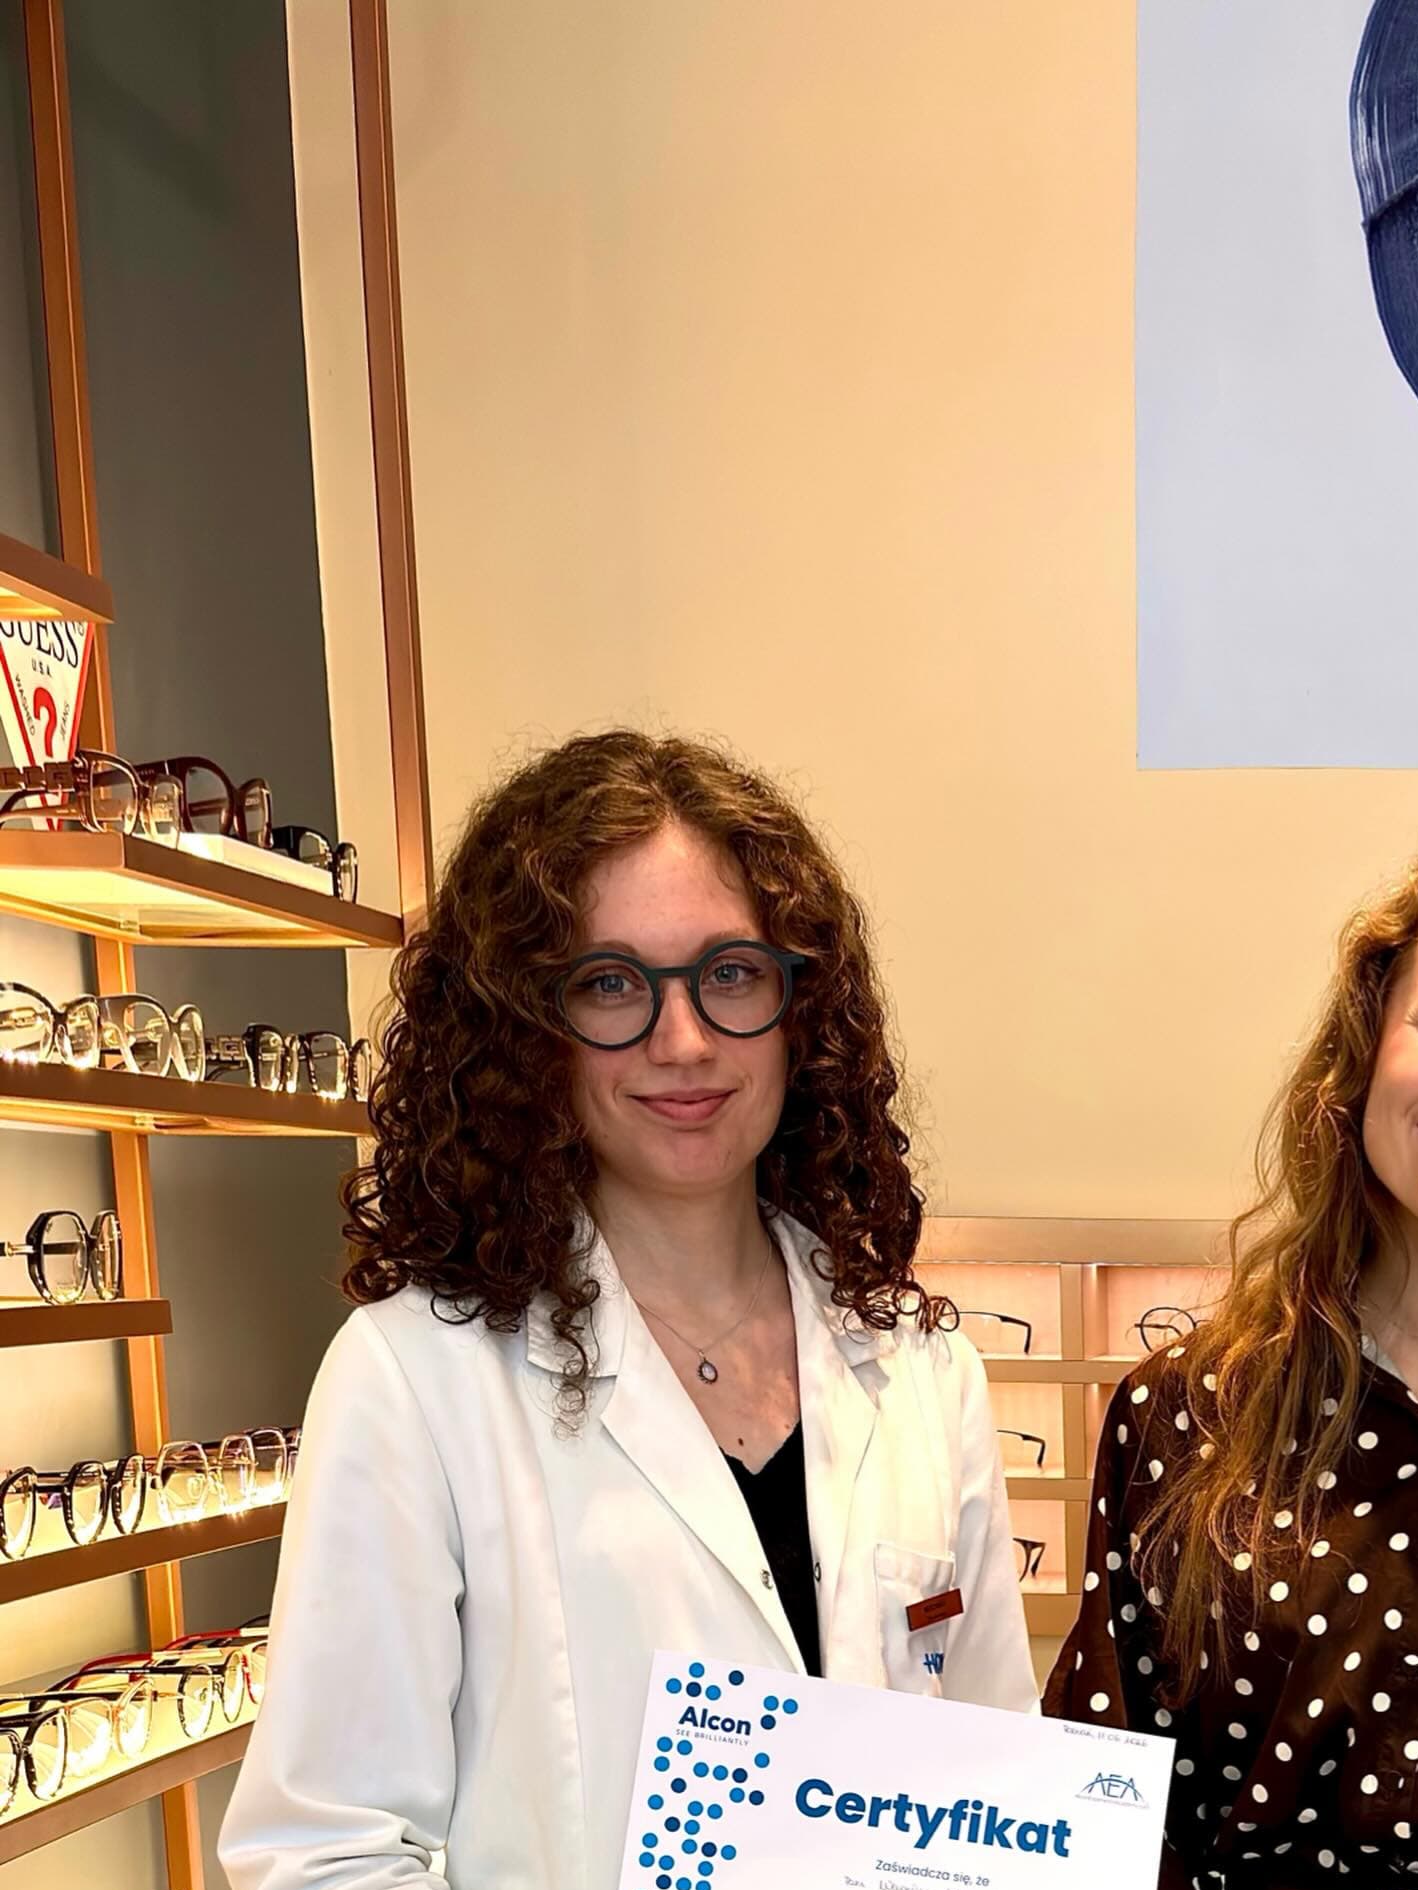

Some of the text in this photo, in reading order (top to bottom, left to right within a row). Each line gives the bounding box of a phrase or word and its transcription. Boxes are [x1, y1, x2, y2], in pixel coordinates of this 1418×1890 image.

[678, 1706, 751, 1736] Alcon
[676, 1729, 749, 1747] SEE BRILLIANTLY
[795, 1778, 1072, 1858] Certyfikat
[875, 1859, 950, 1881] Zaświadcza
